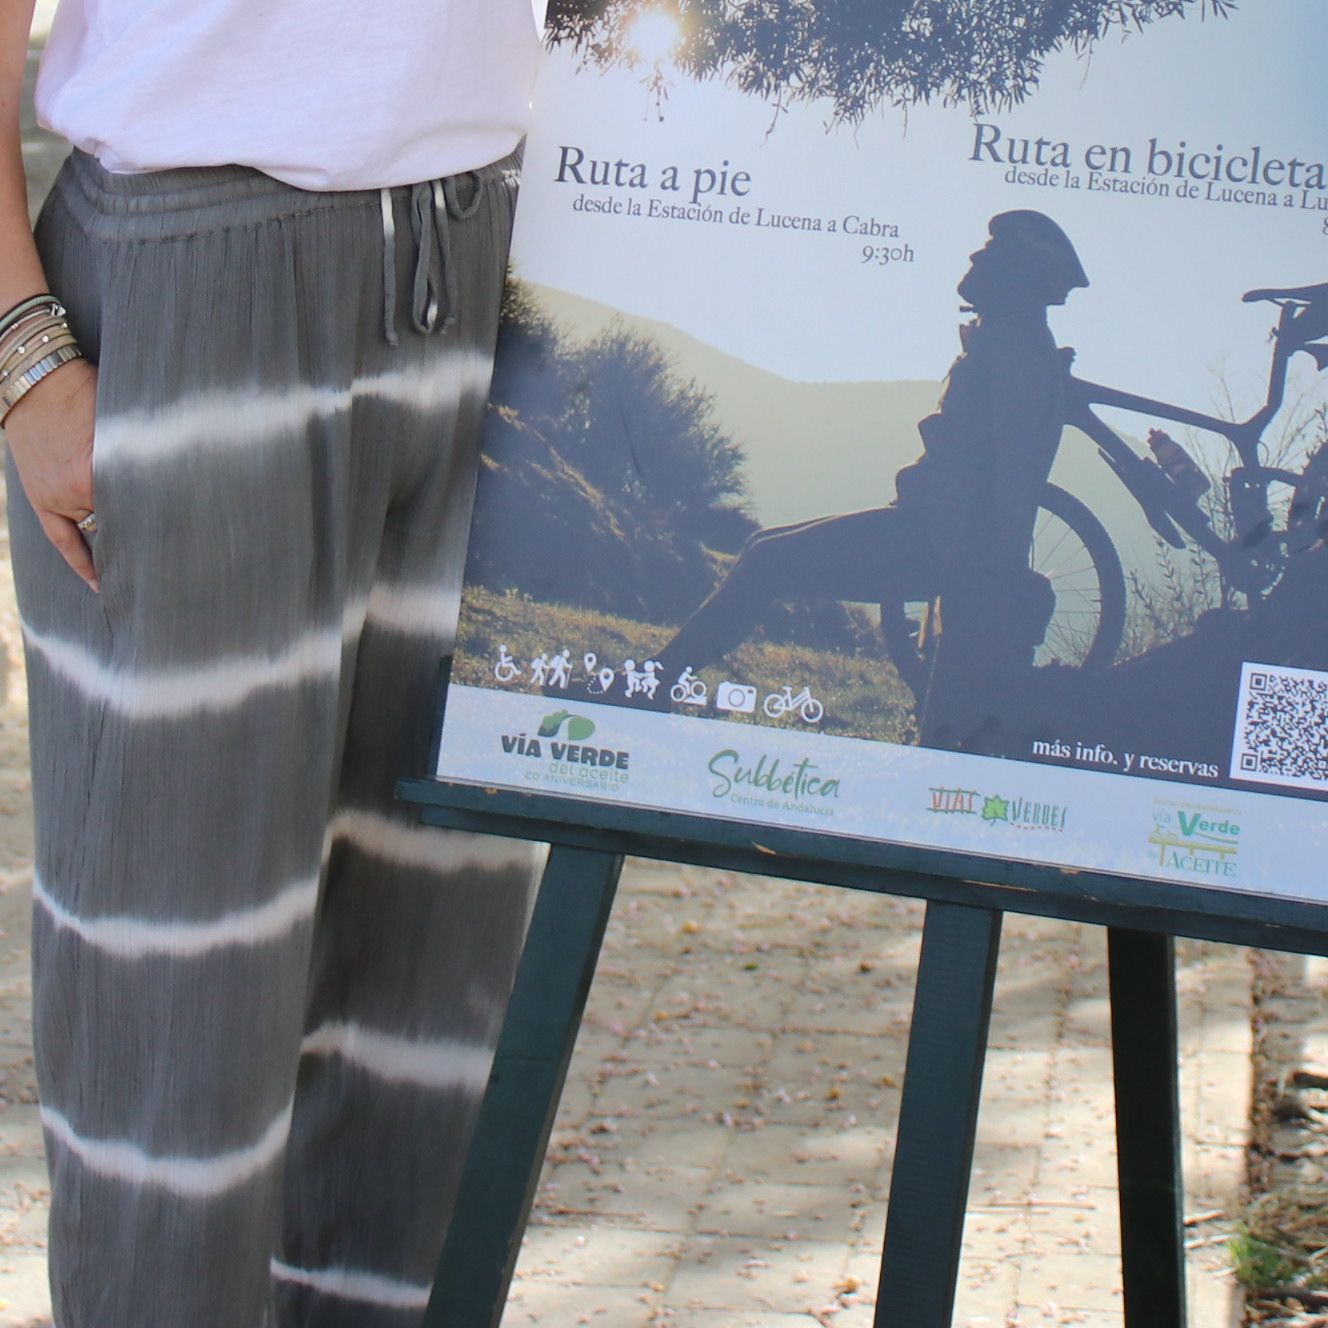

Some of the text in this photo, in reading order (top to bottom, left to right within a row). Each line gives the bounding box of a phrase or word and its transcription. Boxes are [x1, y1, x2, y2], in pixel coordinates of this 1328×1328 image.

[969, 122, 1328, 190] Ruta en bicicleta
[554, 145, 752, 205] Ruta a pie
[1004, 165, 1059, 188] desde
[1063, 168, 1081, 190] la
[1086, 170, 1170, 198] Estación
[1175, 179, 1200, 201] de
[1205, 180, 1278, 207] Lucena
[1283, 193, 1295, 209] a
[572, 193, 900, 239] desde la Estación de Lucena a Cabra
[861, 243, 915, 266] 9:30h
[501, 733, 630, 770] VÍA VERDE
[1032, 739, 1220, 778] más info. y reservas
[524, 770, 620, 792] 20 ANIVERSARIO
[549, 761, 630, 784] del aceite
[730, 793, 765, 807] Centro
[767, 799, 780, 809] de
[1011, 797, 1068, 829] VERDES
[1177, 810, 1241, 836] Verde
[1166, 851, 1238, 877] ACEITE
